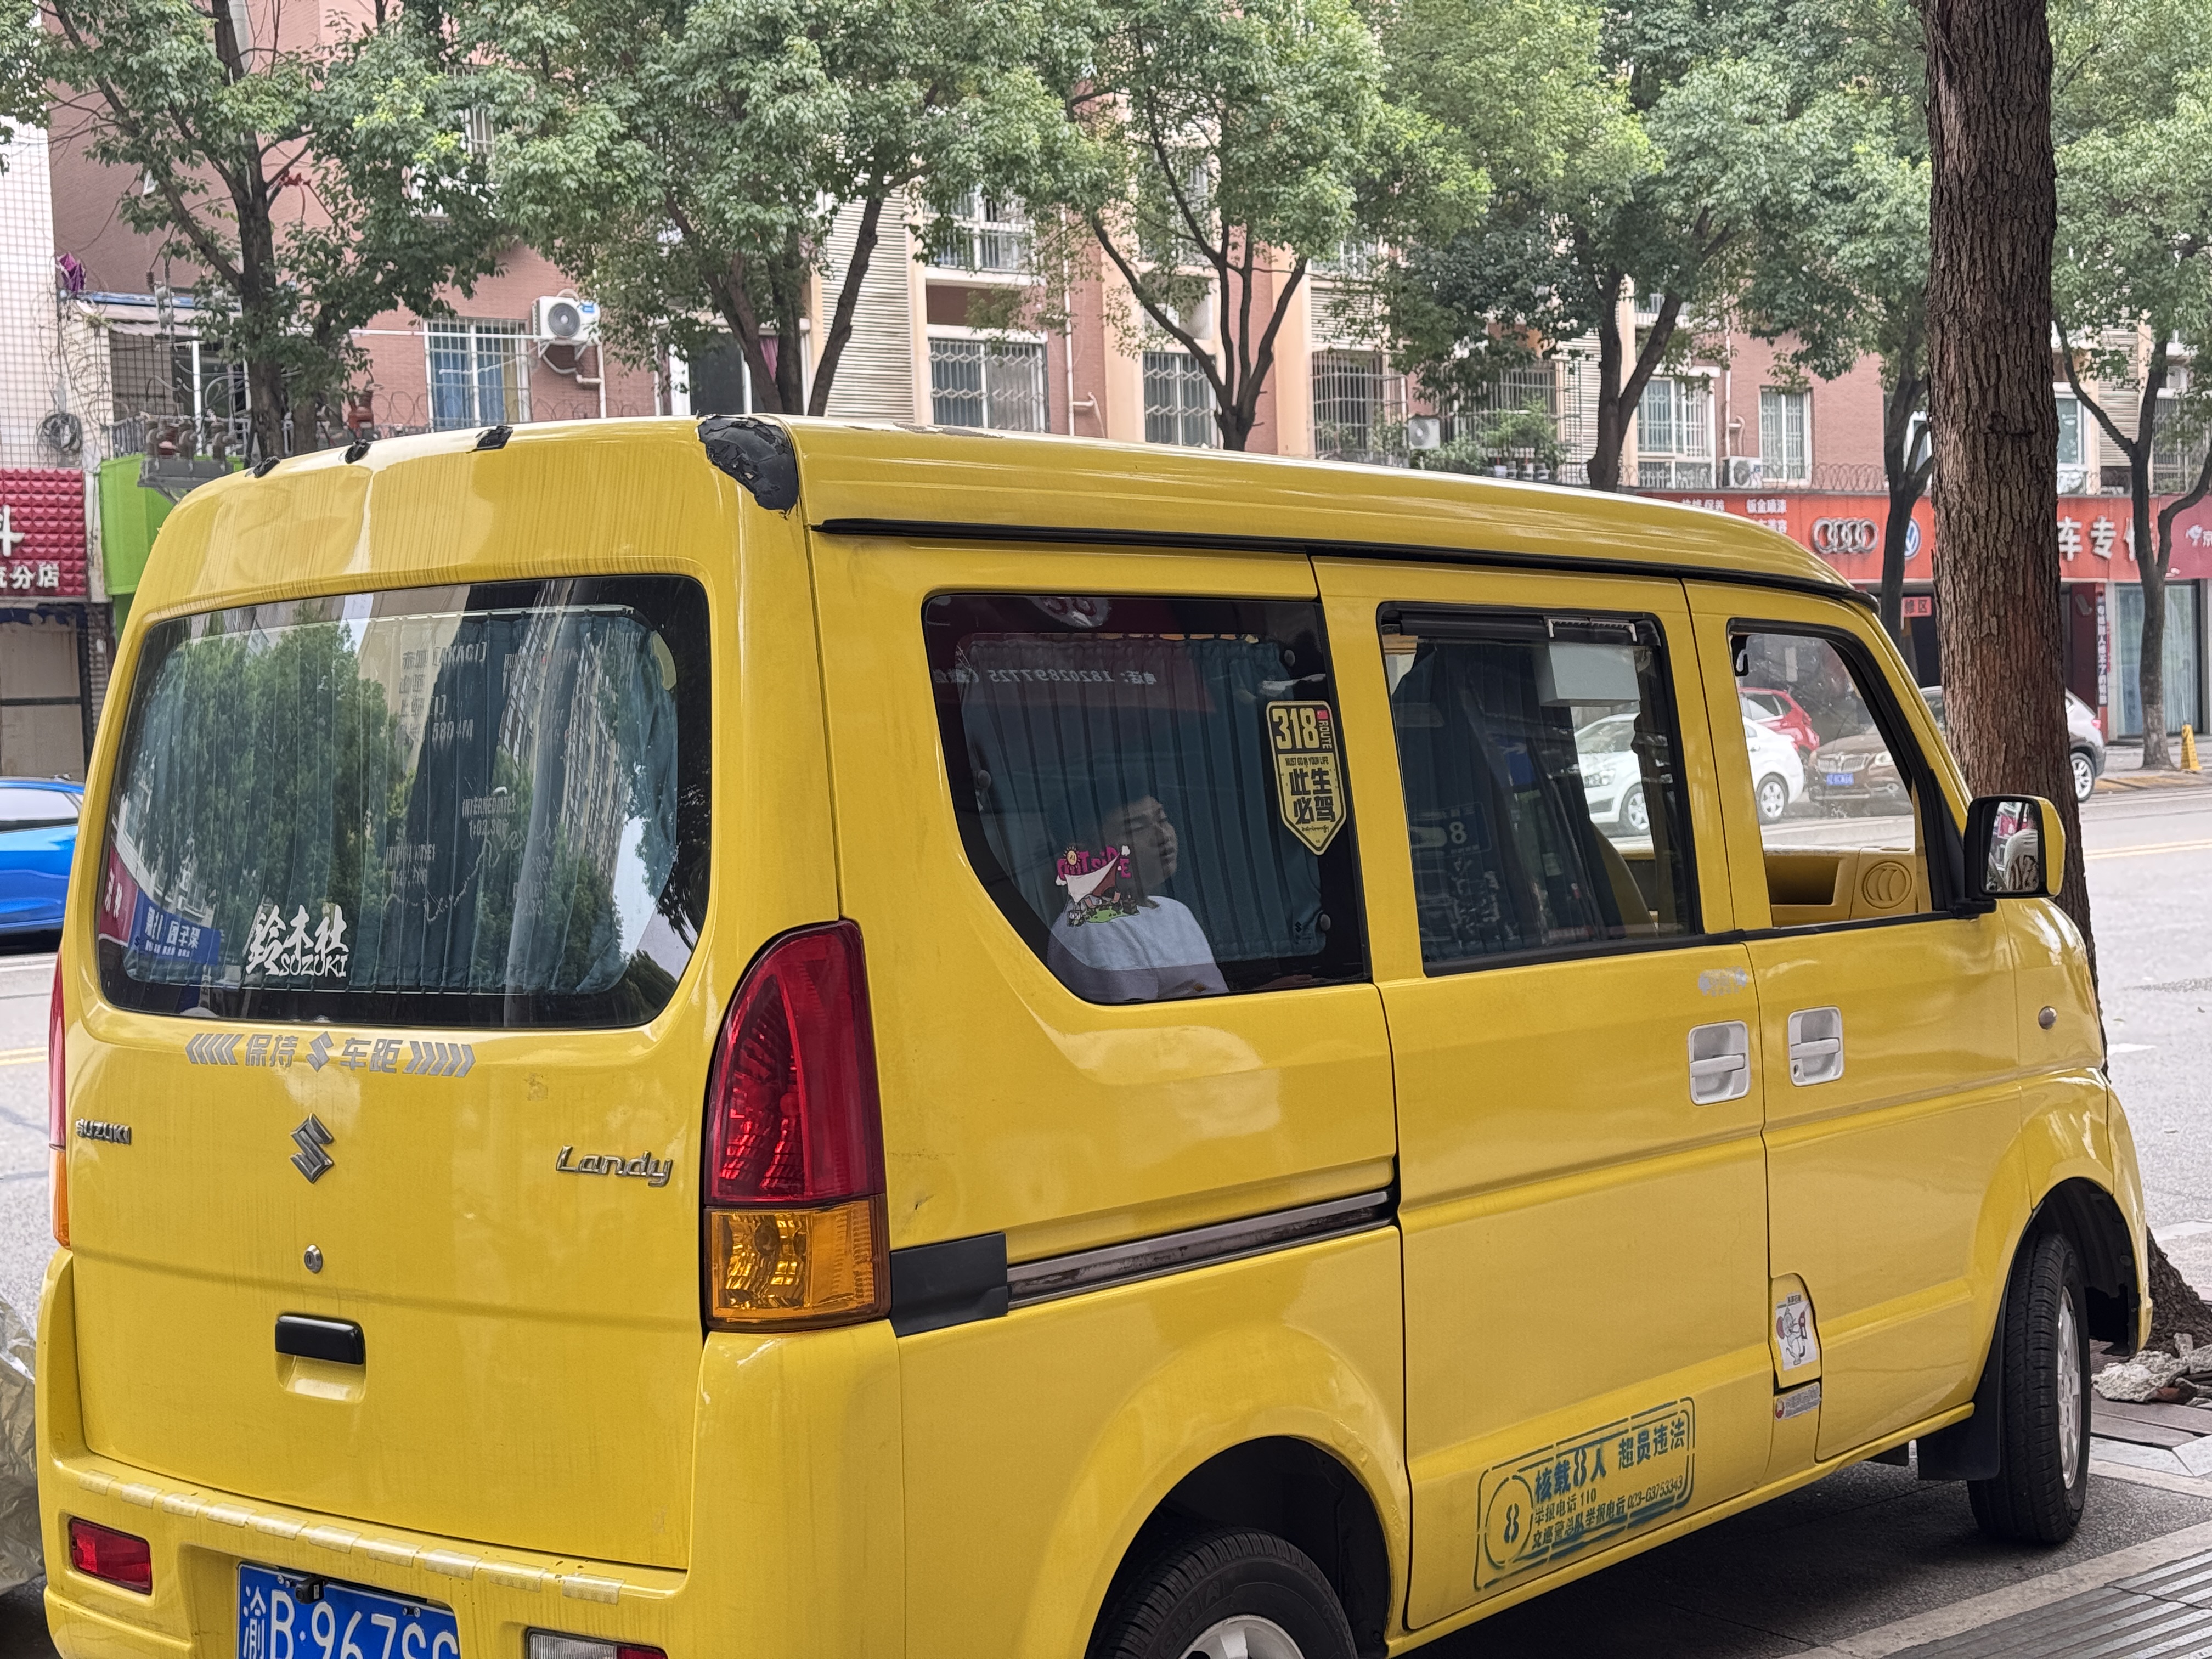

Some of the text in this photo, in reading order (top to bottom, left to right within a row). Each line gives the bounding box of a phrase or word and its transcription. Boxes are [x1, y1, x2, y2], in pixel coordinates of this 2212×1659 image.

[1272, 708, 1320, 749] 318
[1318, 720, 1333, 749] ROUTE
[1285, 757, 1297, 766] MUST
[1320, 756, 1329, 765] LIFE
[1289, 768, 1333, 795] 此生
[1293, 796, 1336, 825] 必驾
[279, 953, 348, 978] SUZUKI
[245, 1034, 404, 1073] 保持 车距
[76, 1118, 132, 1146] SUZUKI
[556, 1144, 674, 1188] Landy
[1618, 1417, 1685, 1470] 超员违法
[1504, 1502, 1520, 1543] 8
[1535, 1488, 1596, 1526] 举报电话 110
